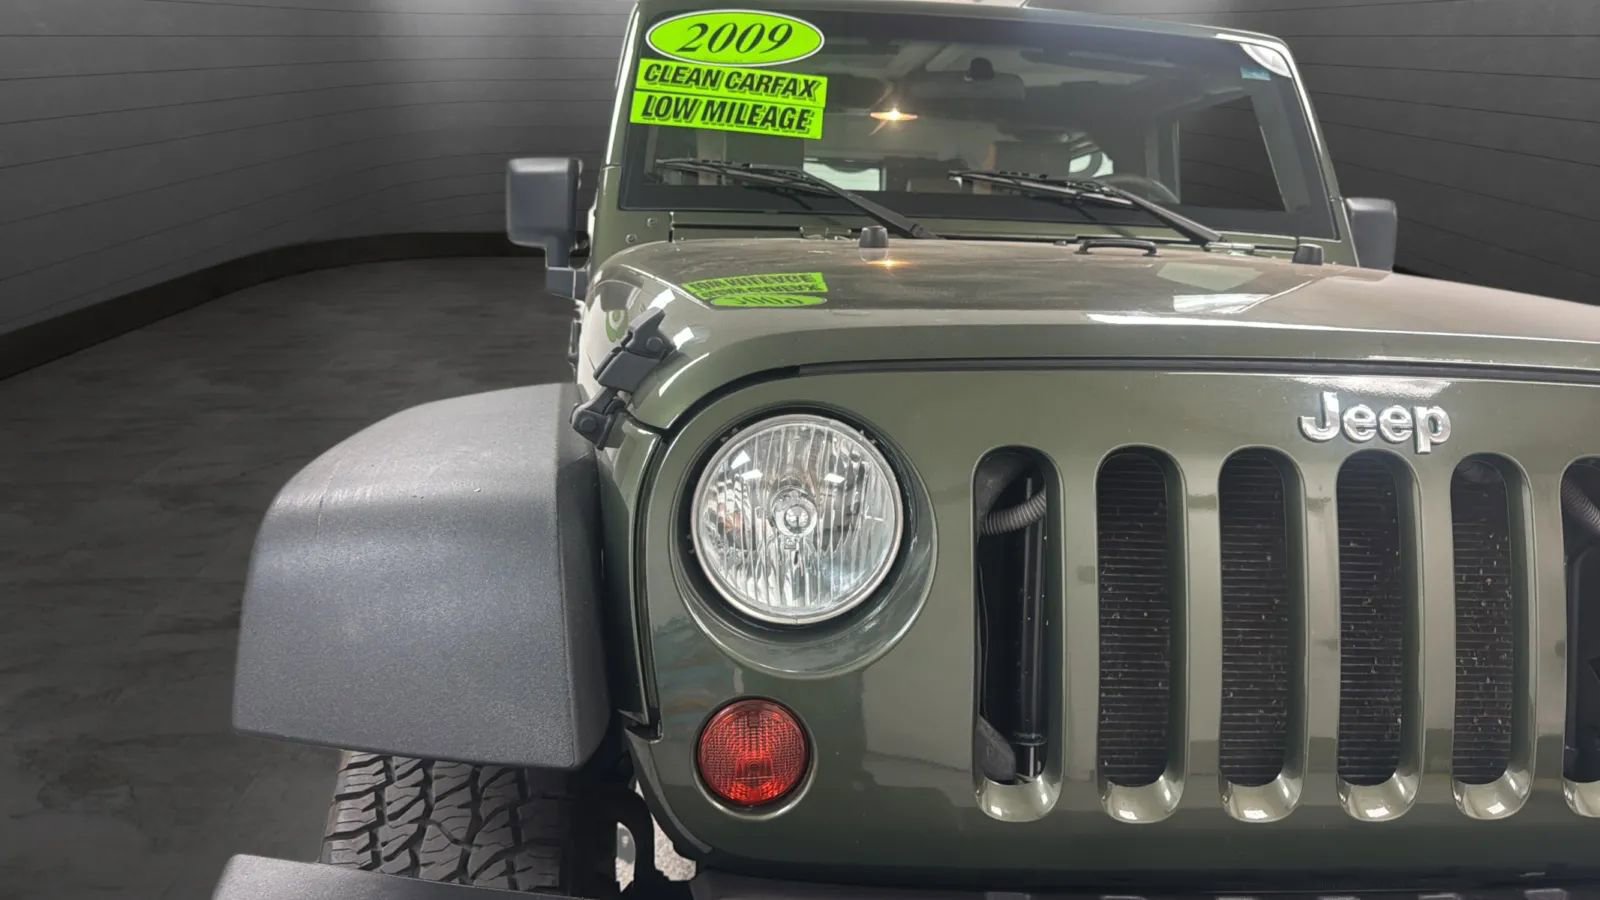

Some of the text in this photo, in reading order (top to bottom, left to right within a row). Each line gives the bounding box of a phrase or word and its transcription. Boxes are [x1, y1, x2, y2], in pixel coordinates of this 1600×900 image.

[676, 23, 793, 54] 2009
[644, 63, 821, 100] CLEAN CARFAX
[642, 95, 815, 133] LOW MILEAGE
[1299, 391, 1451, 453] Jeep
